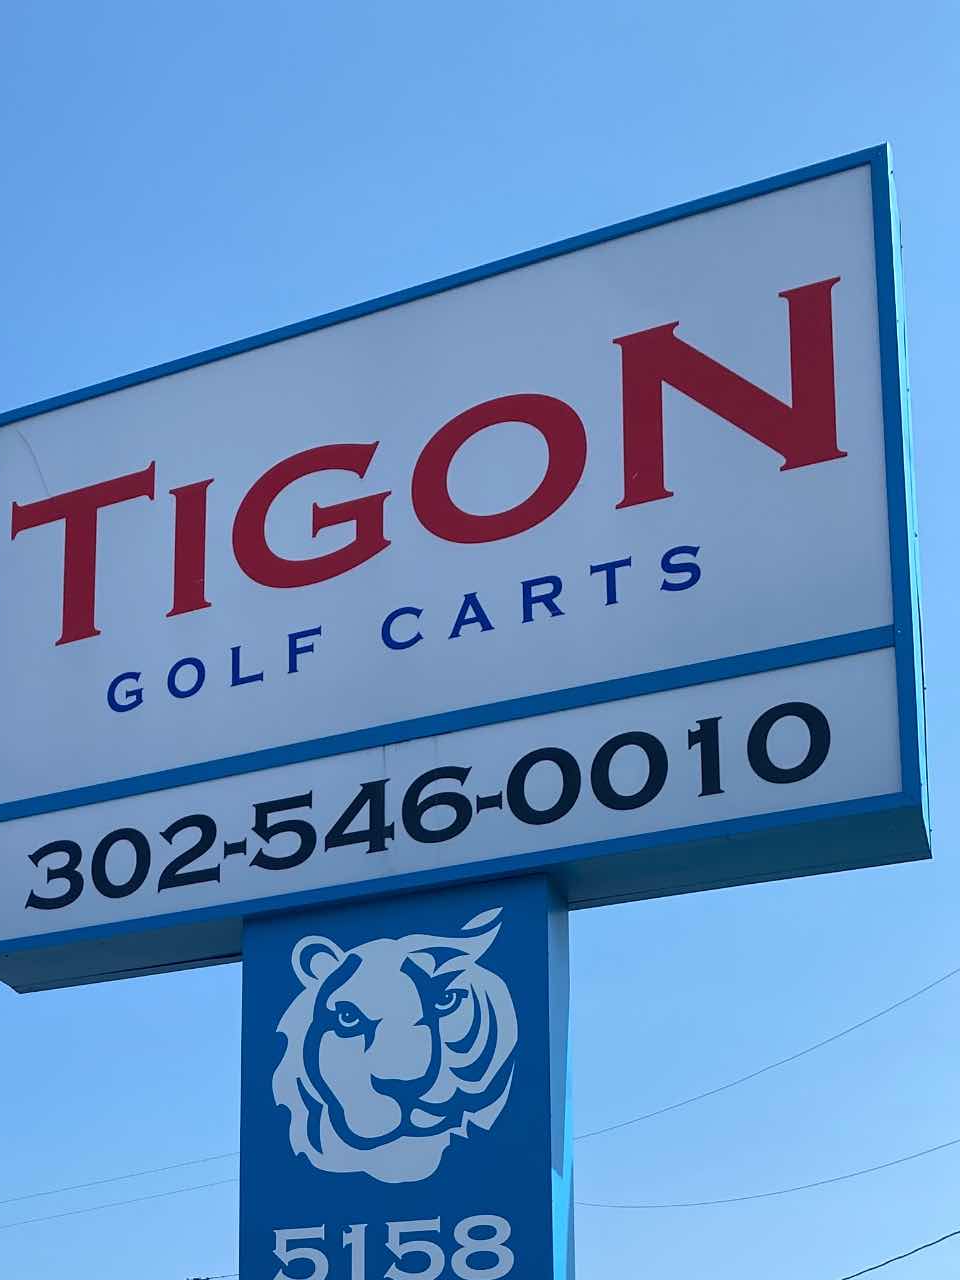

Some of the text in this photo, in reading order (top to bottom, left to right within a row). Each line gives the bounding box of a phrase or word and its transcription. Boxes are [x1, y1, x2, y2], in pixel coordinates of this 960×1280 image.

[11, 278, 847, 645] TIGON
[107, 546, 701, 712] GOLF CARTS
[25, 702, 831, 910] 302-546-0010
